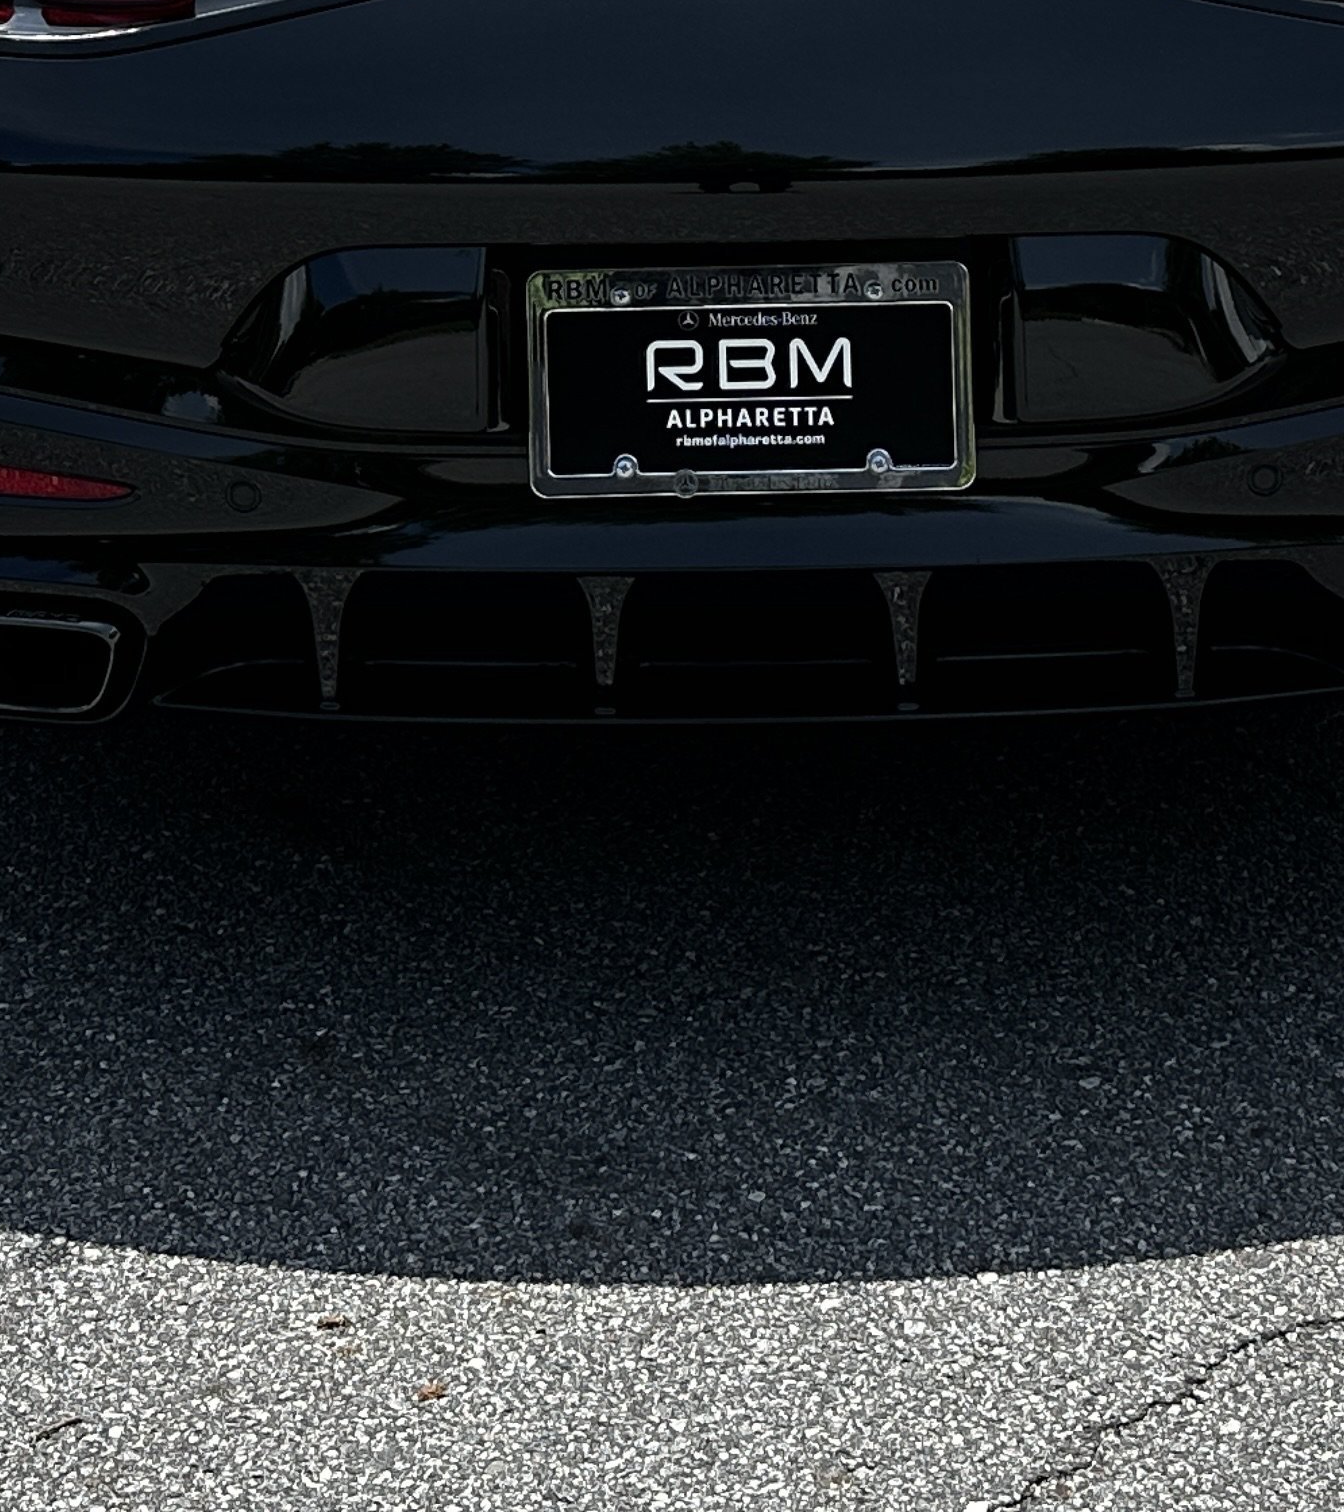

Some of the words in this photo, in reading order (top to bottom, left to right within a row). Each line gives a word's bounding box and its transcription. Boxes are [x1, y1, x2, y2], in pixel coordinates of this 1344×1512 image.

[548, 278, 607, 302] RBM
[665, 272, 859, 300] ALPHARETTA
[708, 312, 818, 327] Mercedes-Benz
[646, 337, 852, 392] RBM
[666, 406, 835, 429] ALPHARETTA
[676, 433, 826, 449] rbmofalpharetta.com
